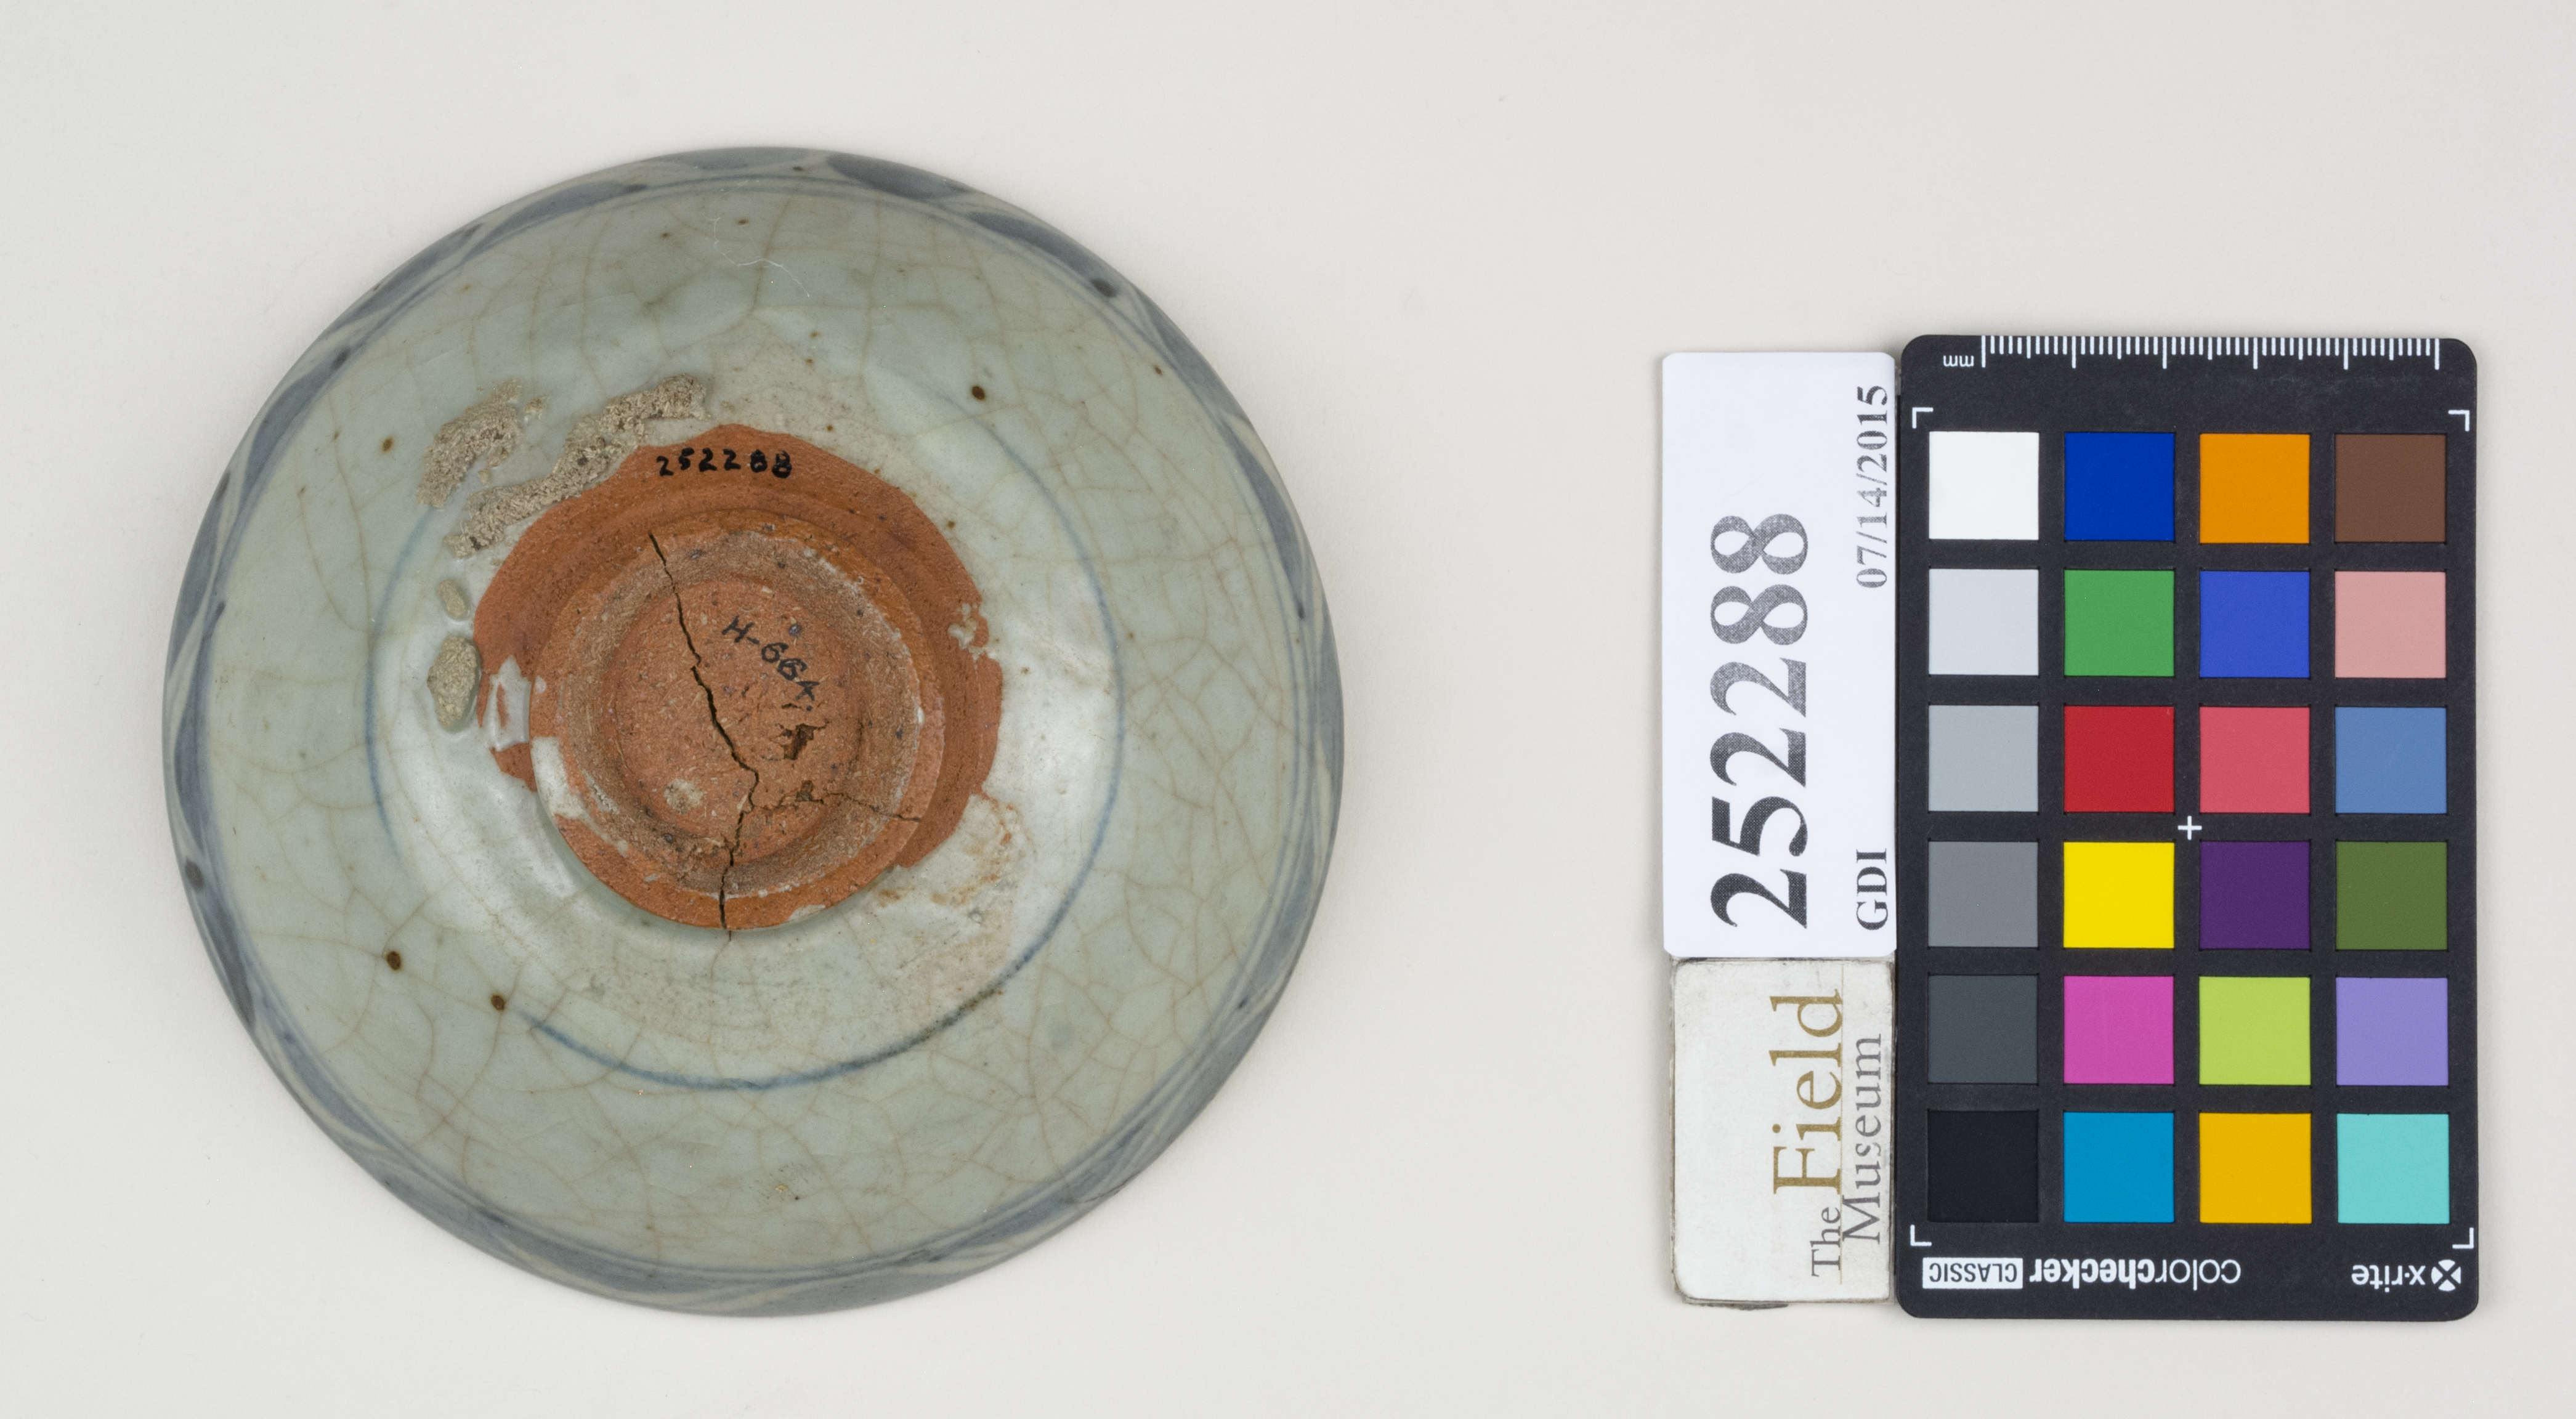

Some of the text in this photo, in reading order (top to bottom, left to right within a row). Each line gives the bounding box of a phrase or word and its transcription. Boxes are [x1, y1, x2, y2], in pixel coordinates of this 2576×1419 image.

[656, 447, 793, 479] 252288
[1943, 355, 1974, 368] mm
[1709, 513, 1808, 929] 252288
[1856, 385, 1889, 931] GDI 07/14/2015
[1768, 988, 1843, 1277] The Field
[1841, 1033, 1882, 1245] Museum
[1928, 1258, 2241, 1290] colorchecker CLASSIC
